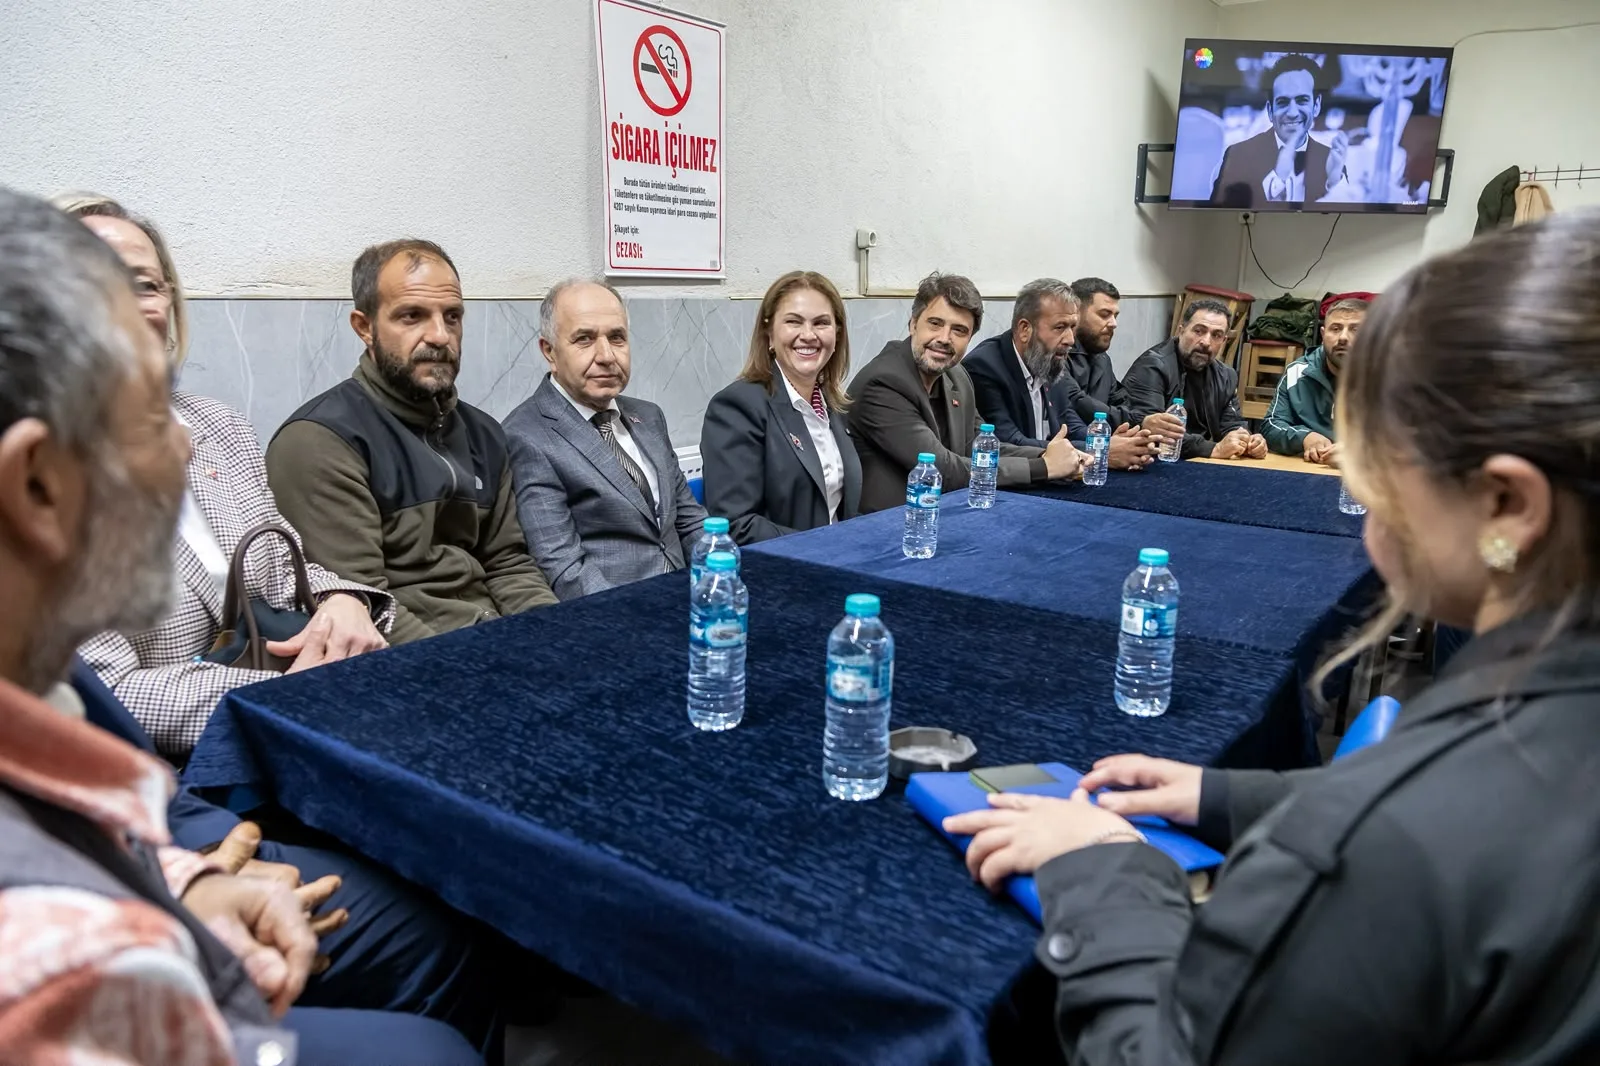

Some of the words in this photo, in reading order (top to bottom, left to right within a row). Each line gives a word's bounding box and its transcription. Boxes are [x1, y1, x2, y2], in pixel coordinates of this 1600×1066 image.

[611, 112, 661, 165] SİGARA
[665, 121, 717, 178] İÇİLMEZ
[624, 176, 638, 187] Burada
[639, 178, 650, 188] tütün
[651, 180, 667, 190] ürünleri
[639, 193, 644, 201] ve
[613, 202, 624, 211] 4207
[677, 209, 686, 218] para
[614, 224, 630, 235] Şikayet
